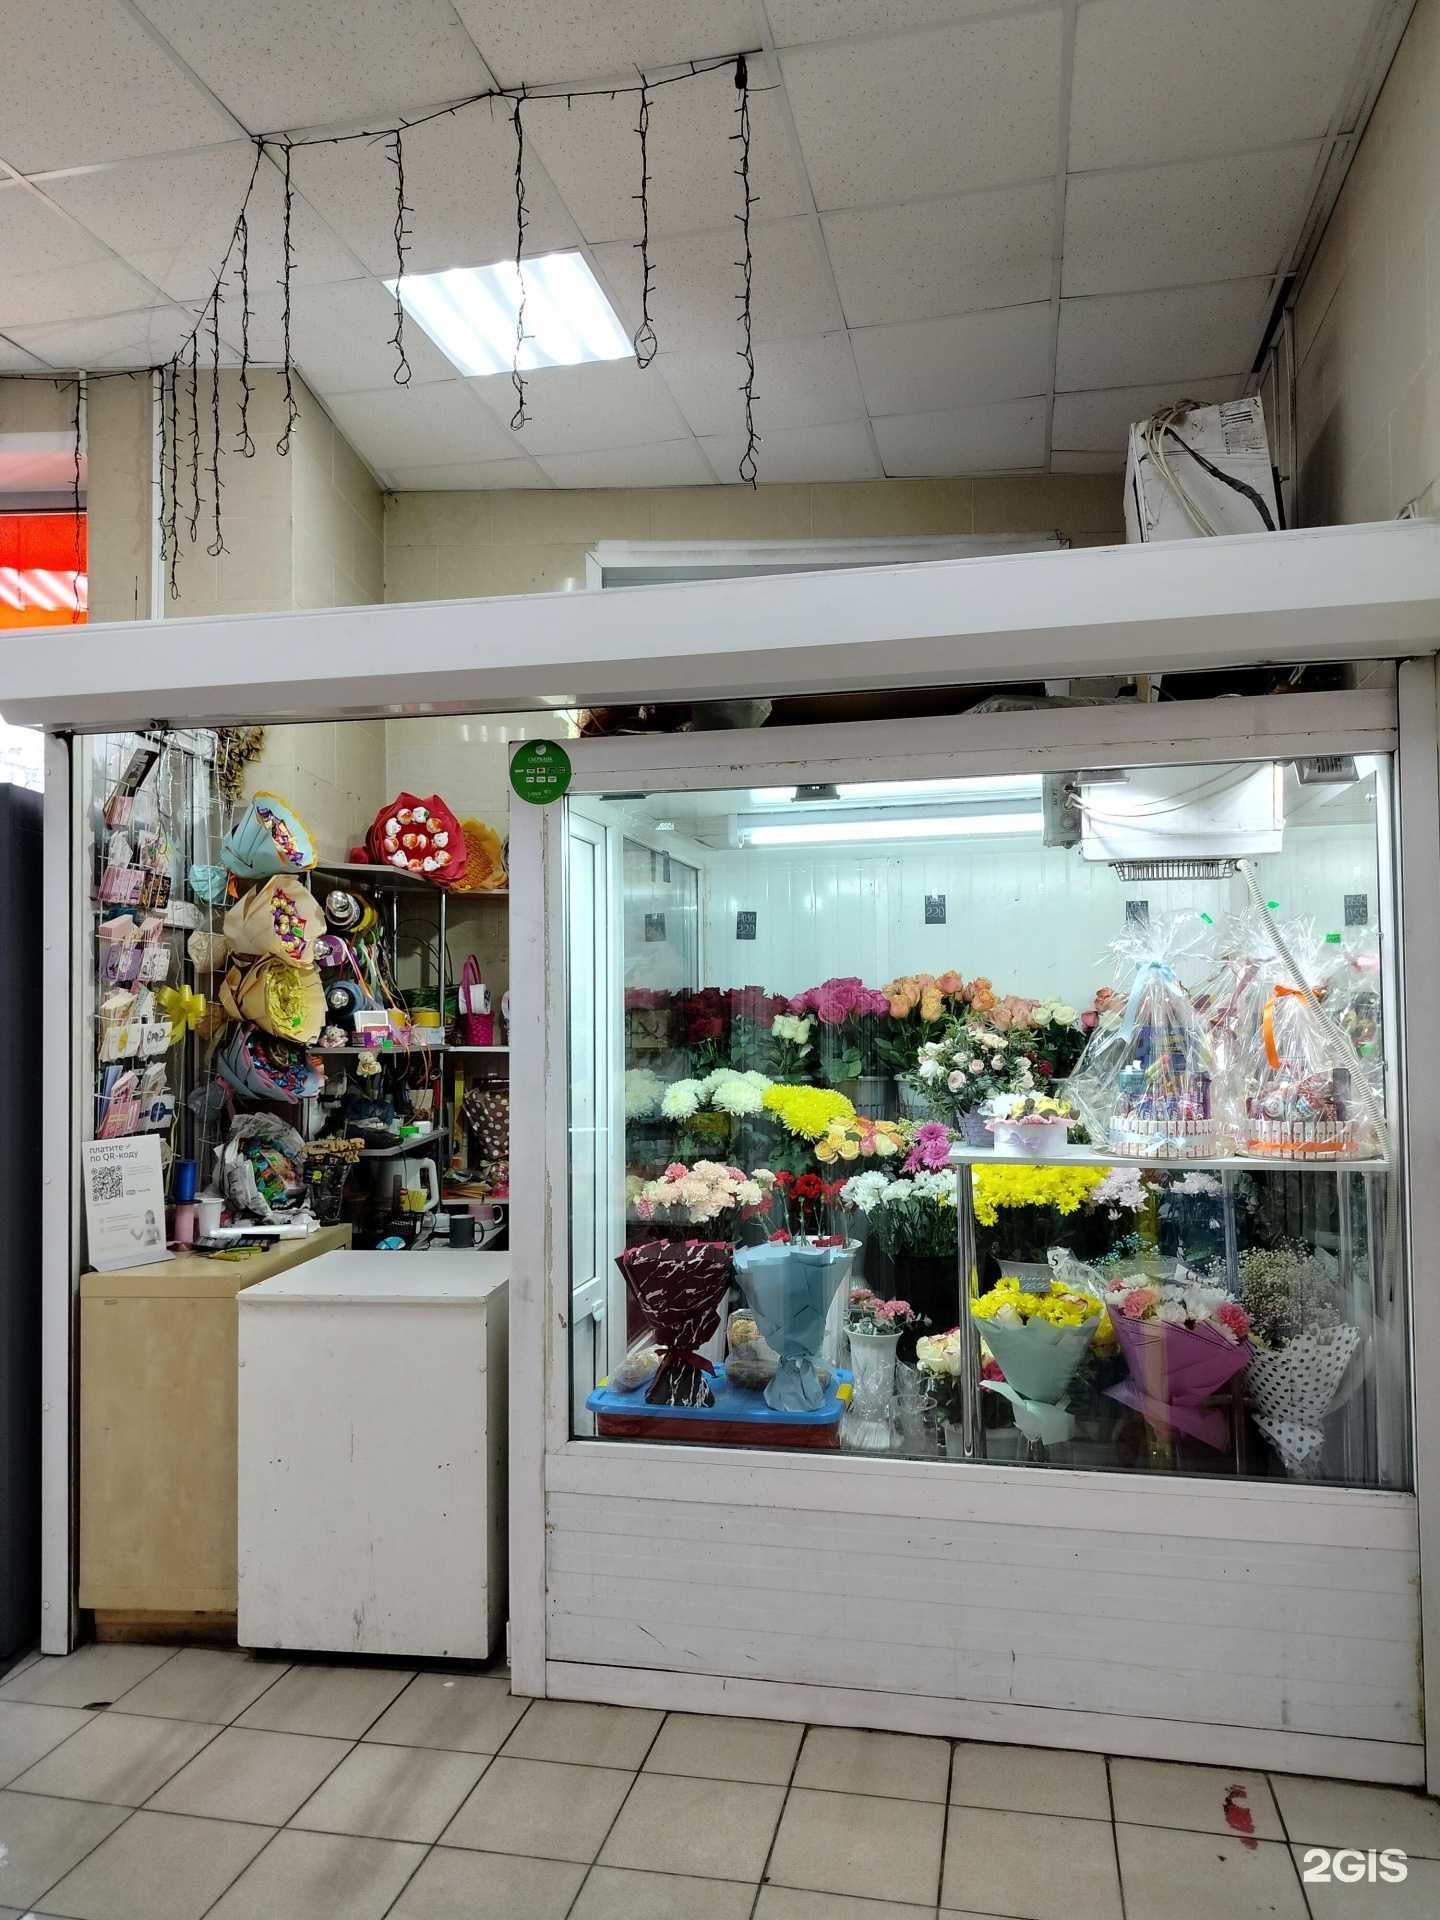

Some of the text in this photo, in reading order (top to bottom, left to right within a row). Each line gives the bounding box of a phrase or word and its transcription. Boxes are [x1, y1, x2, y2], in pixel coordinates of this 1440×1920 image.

[89, 1144, 124, 1154] платите
[90, 1152, 139, 1163] по QR-коду
